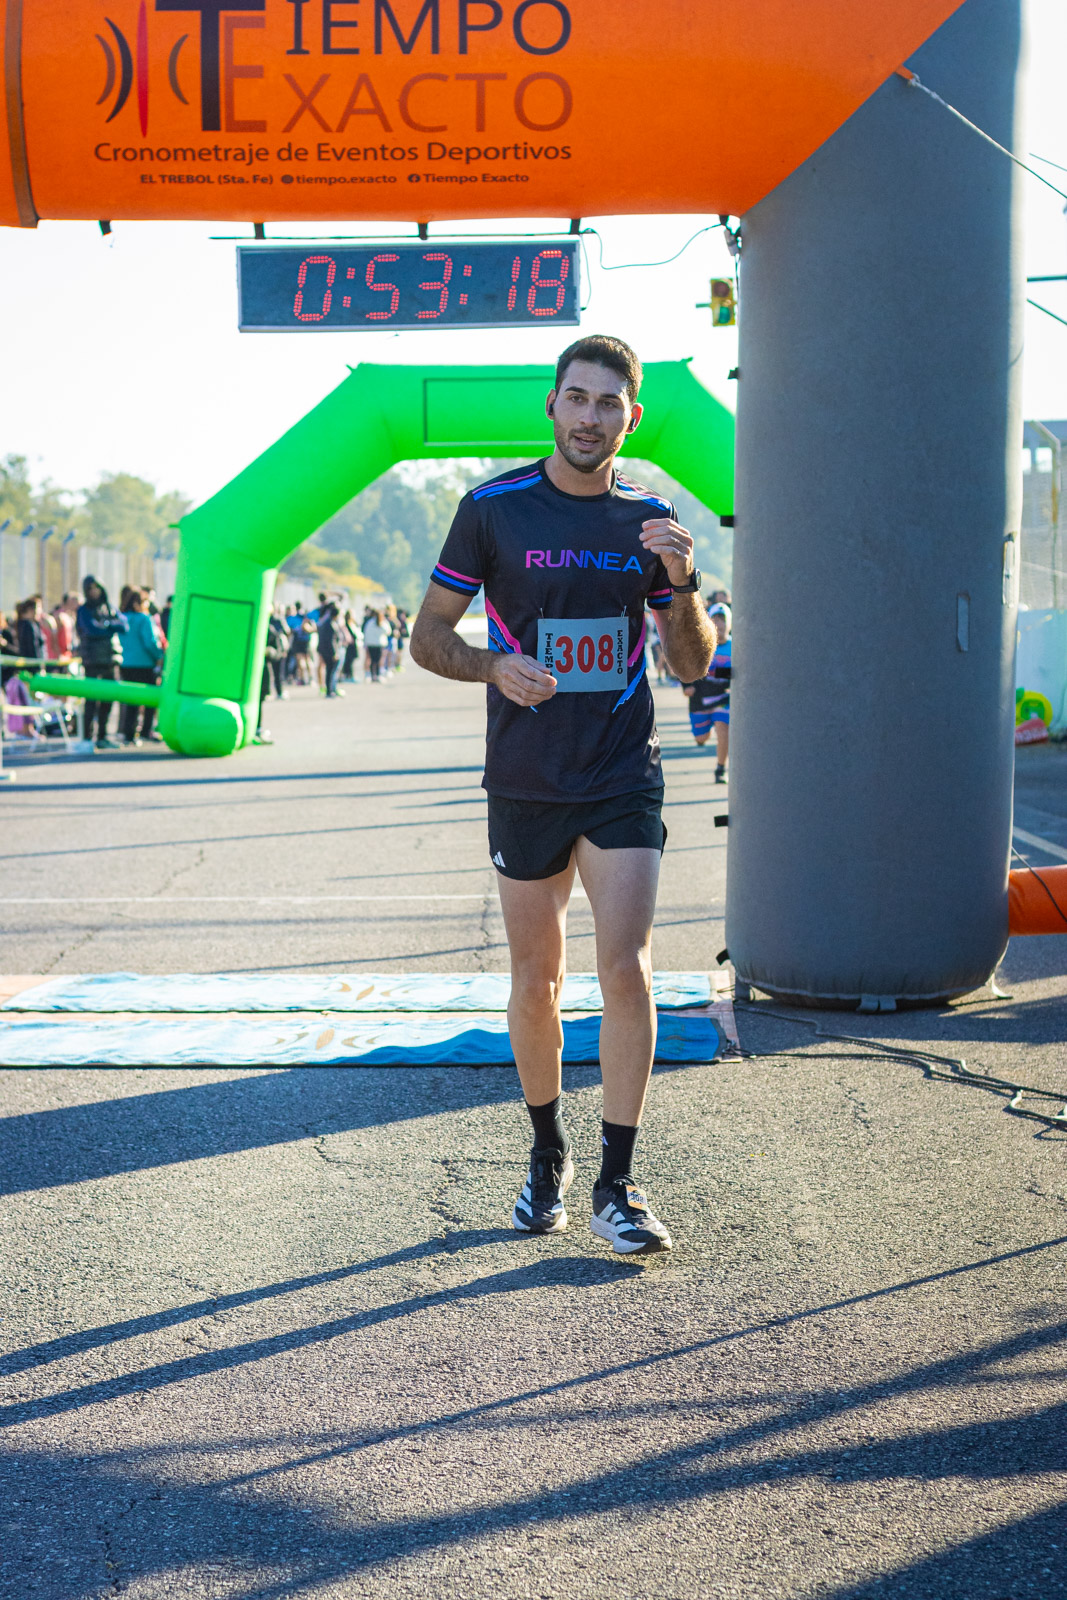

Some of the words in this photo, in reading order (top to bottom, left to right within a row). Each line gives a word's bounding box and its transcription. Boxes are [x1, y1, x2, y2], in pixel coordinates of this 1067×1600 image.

[94, 142, 270, 166] Cronometraje
[276, 142, 309, 162] de
[317, 142, 419, 162] Eventos
[427, 142, 572, 165] Deportivos
[140, 174, 156, 185] EL
[158, 174, 215, 185] TREBOL
[217, 174, 249, 186] (Sta.
[252, 174, 274, 186] Fe)
[296, 174, 398, 187] tiempo.exacto
[423, 173, 478, 185] Tiempo
[481, 173, 530, 184] Exacto
[525, 549, 643, 575] RUNNEA
[544, 632, 554, 677] TIEMP
[555, 633, 614, 674] 308
[616, 629, 624, 675] EXACTO
